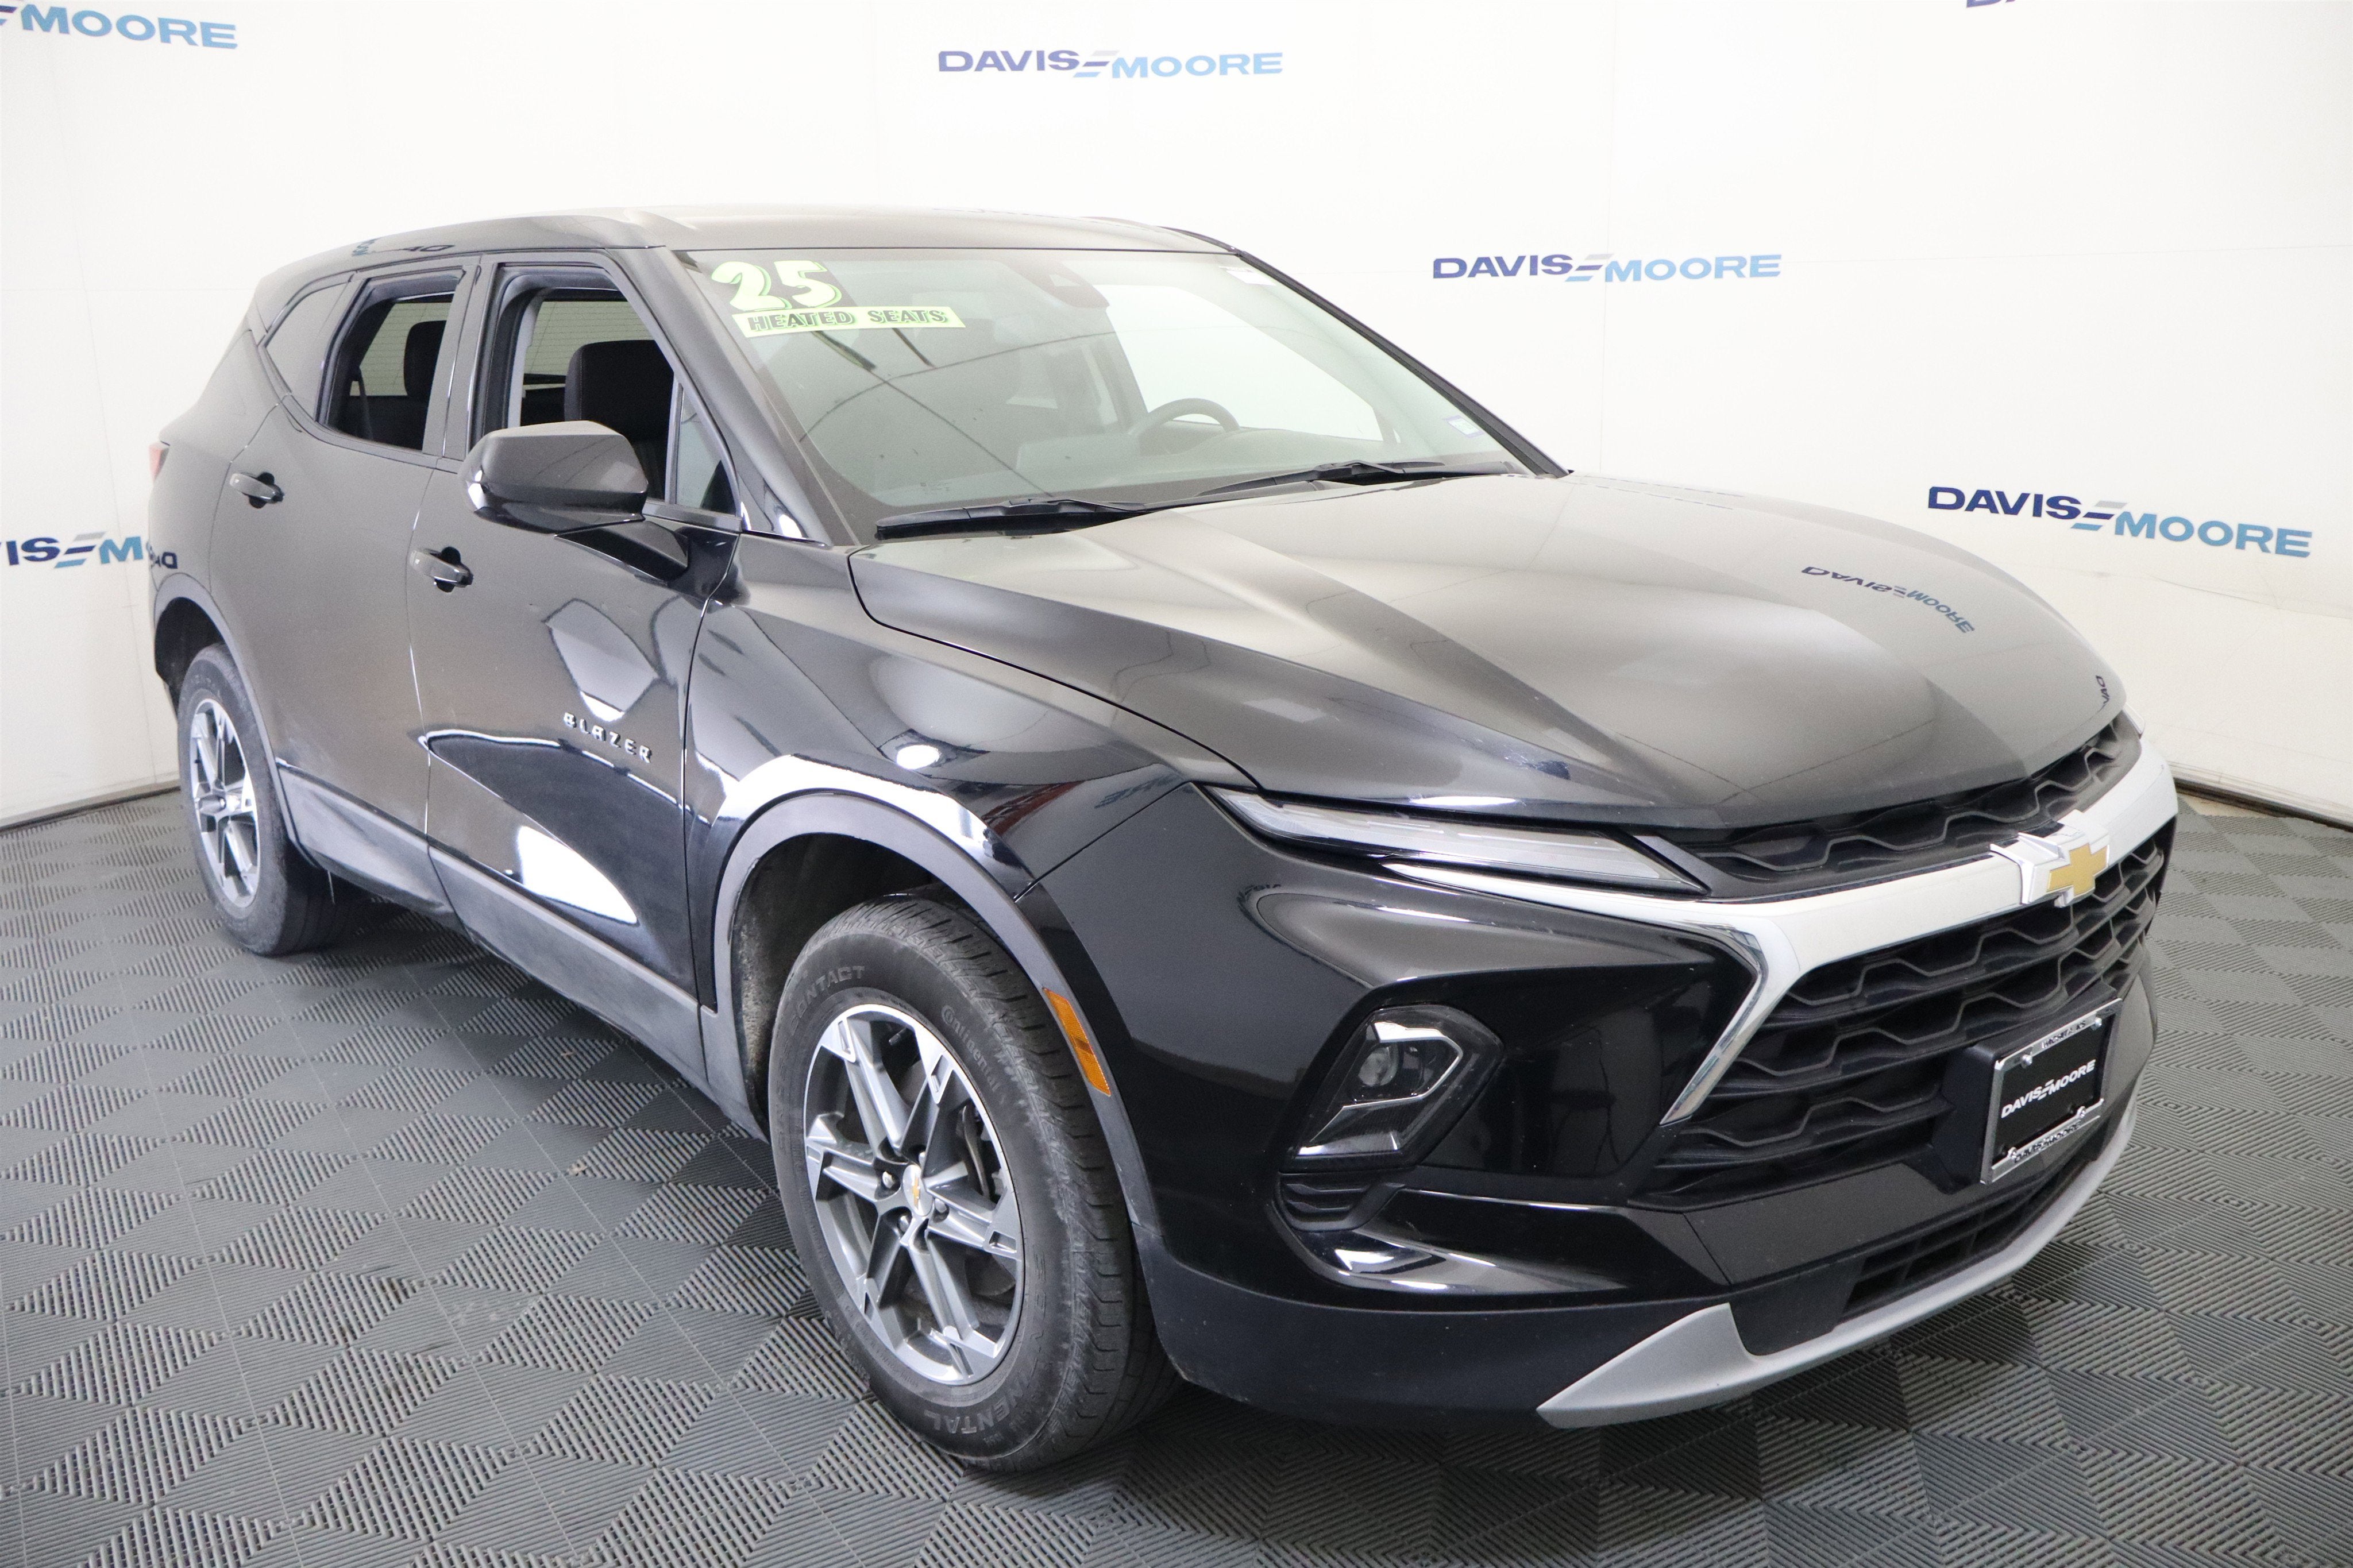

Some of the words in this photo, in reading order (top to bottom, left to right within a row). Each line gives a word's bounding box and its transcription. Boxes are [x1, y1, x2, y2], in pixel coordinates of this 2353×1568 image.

[21, 4, 238, 49] MOORE
[939, 50, 1080, 72] DAVIS
[1112, 52, 1283, 79] MOORE
[711, 260, 842, 311] 25
[1433, 254, 1573, 279] DAVIS
[1604, 254, 1781, 282] MOORE
[748, 311, 855, 331] HEATED
[866, 309, 948, 324] SEATS
[1928, 486, 2082, 520] DAVIS
[2114, 511, 2312, 558] MOORE
[563, 712, 652, 764] BLAZER
[941, 1005, 1000, 1092] Continental
[2001, 1086, 2043, 1119] DAVIS
[2047, 1059, 2096, 1095] MOORE
